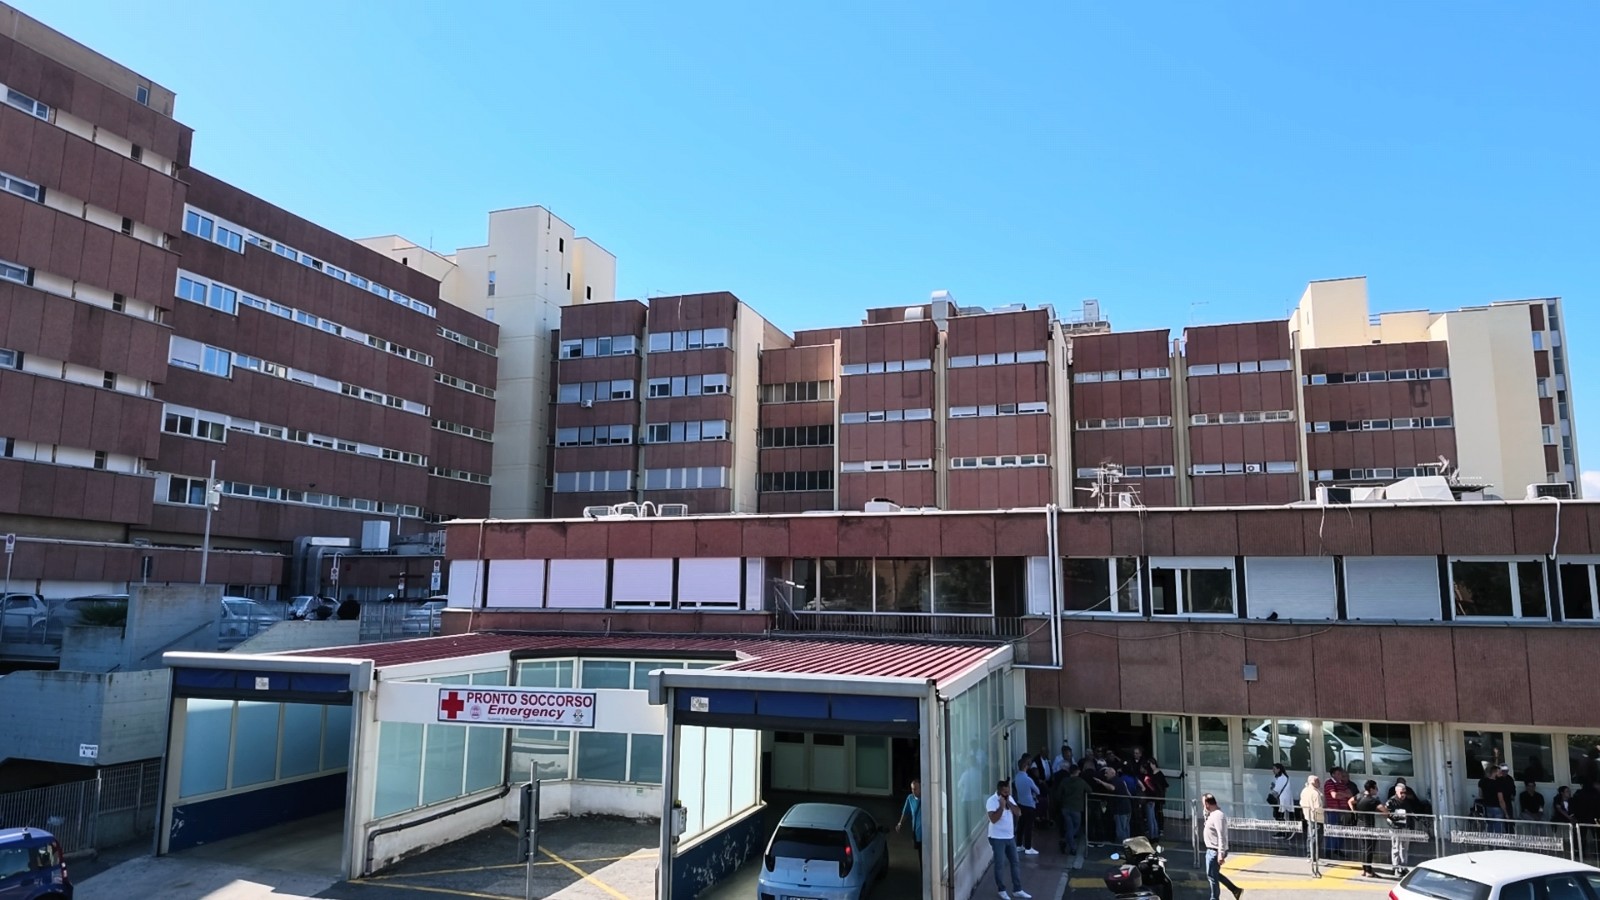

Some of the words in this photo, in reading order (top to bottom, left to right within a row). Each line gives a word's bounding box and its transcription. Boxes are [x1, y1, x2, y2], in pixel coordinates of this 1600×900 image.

[466, 692, 517, 705] PRONTO
[520, 694, 592, 708] SOCCORSO
[487, 704, 565, 719] Emergency
